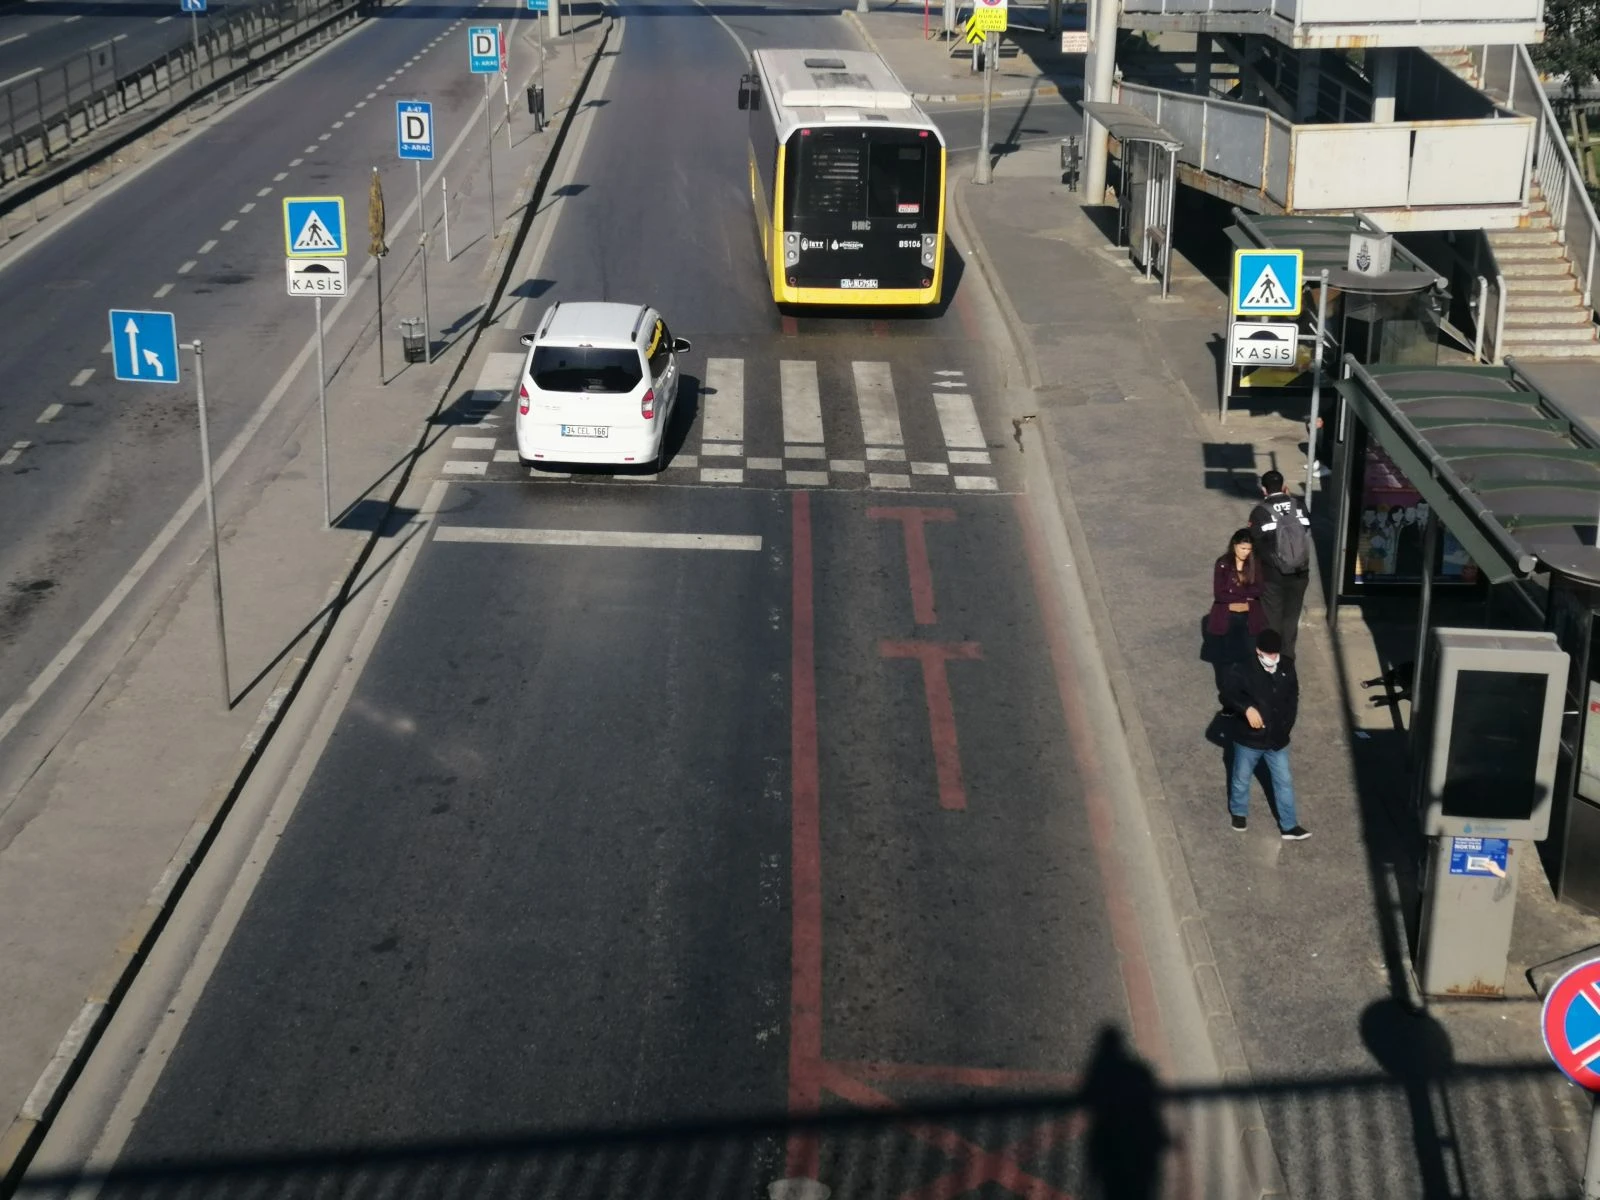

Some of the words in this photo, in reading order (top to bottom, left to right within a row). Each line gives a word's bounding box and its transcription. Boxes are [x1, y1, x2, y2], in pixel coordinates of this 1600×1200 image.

[476, 35, 492, 55] D
[406, 115, 425, 140] D
[292, 277, 342, 291] KASİS
[1235, 345, 1290, 360] KASİS
[566, 426, 575, 434] 34
[593, 427, 606, 436] 166
